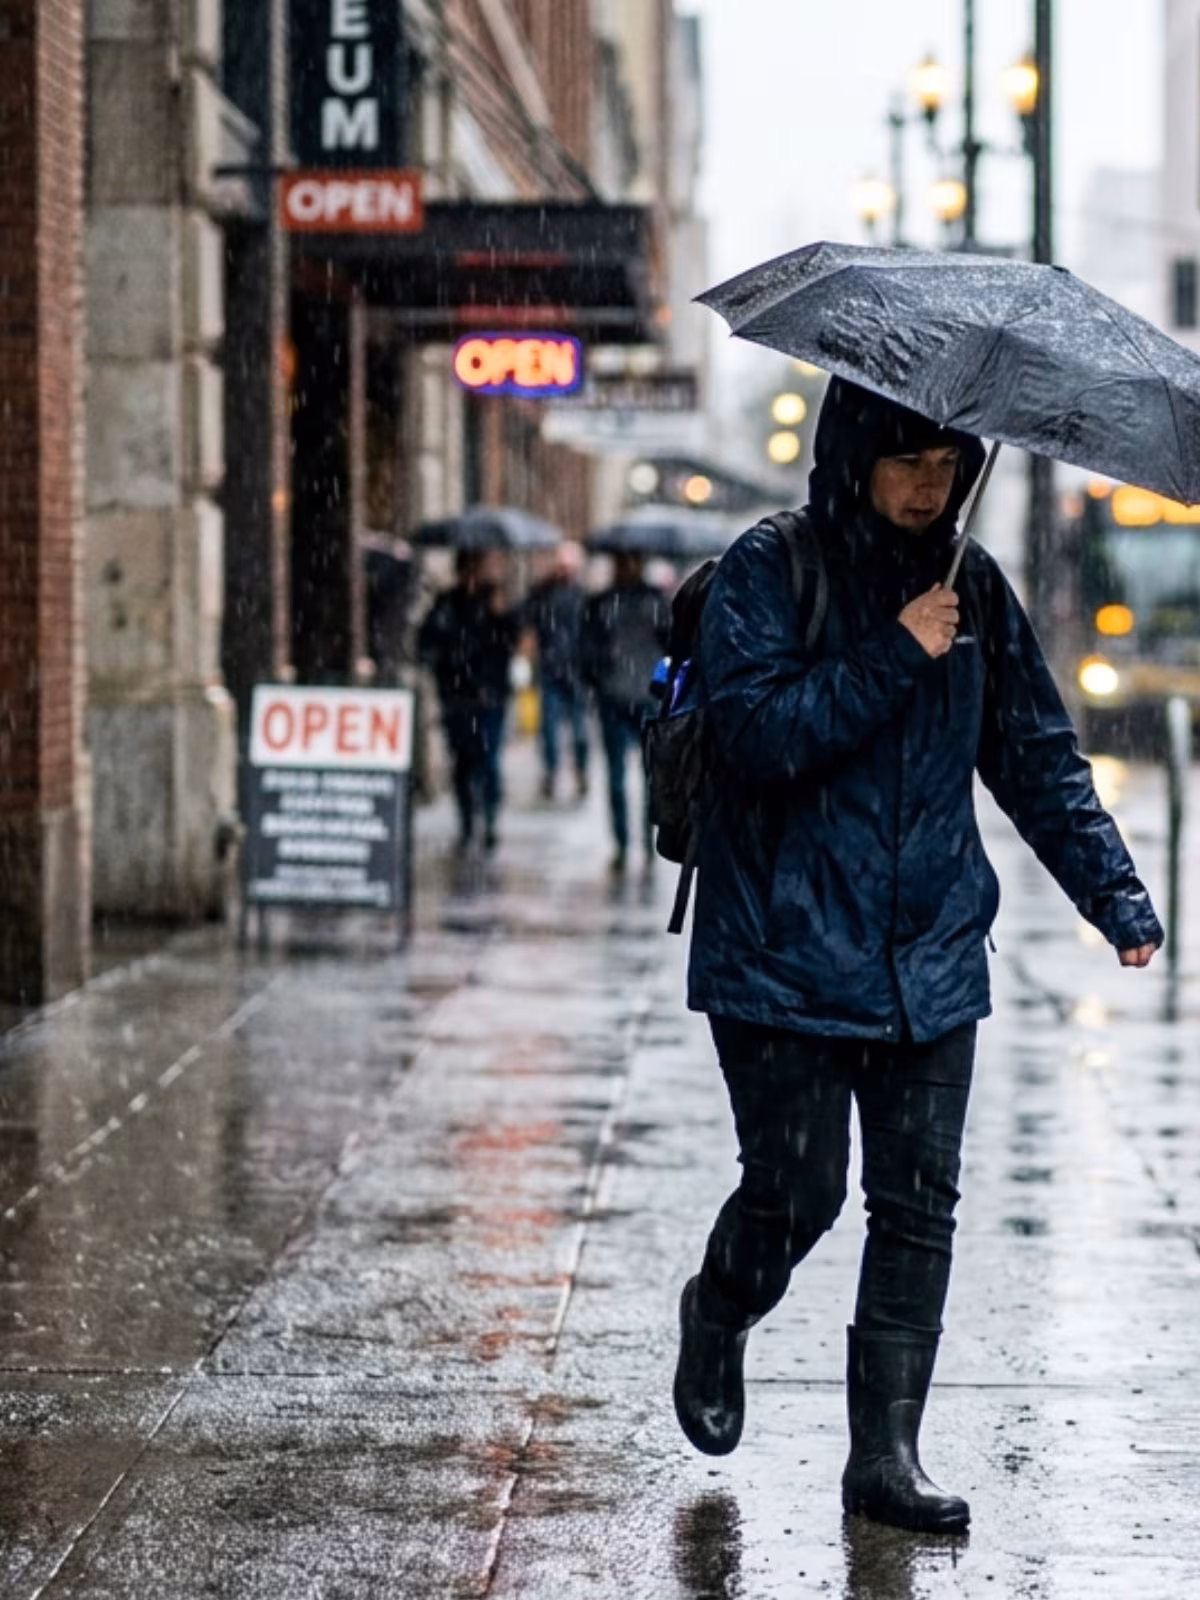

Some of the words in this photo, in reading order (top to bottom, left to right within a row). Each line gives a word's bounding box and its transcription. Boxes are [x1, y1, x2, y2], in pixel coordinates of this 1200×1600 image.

[321, 0, 380, 150] EUM
[286, 178, 414, 223] OPEN
[455, 338, 574, 387] OPEN
[262, 701, 400, 754] OPEN
